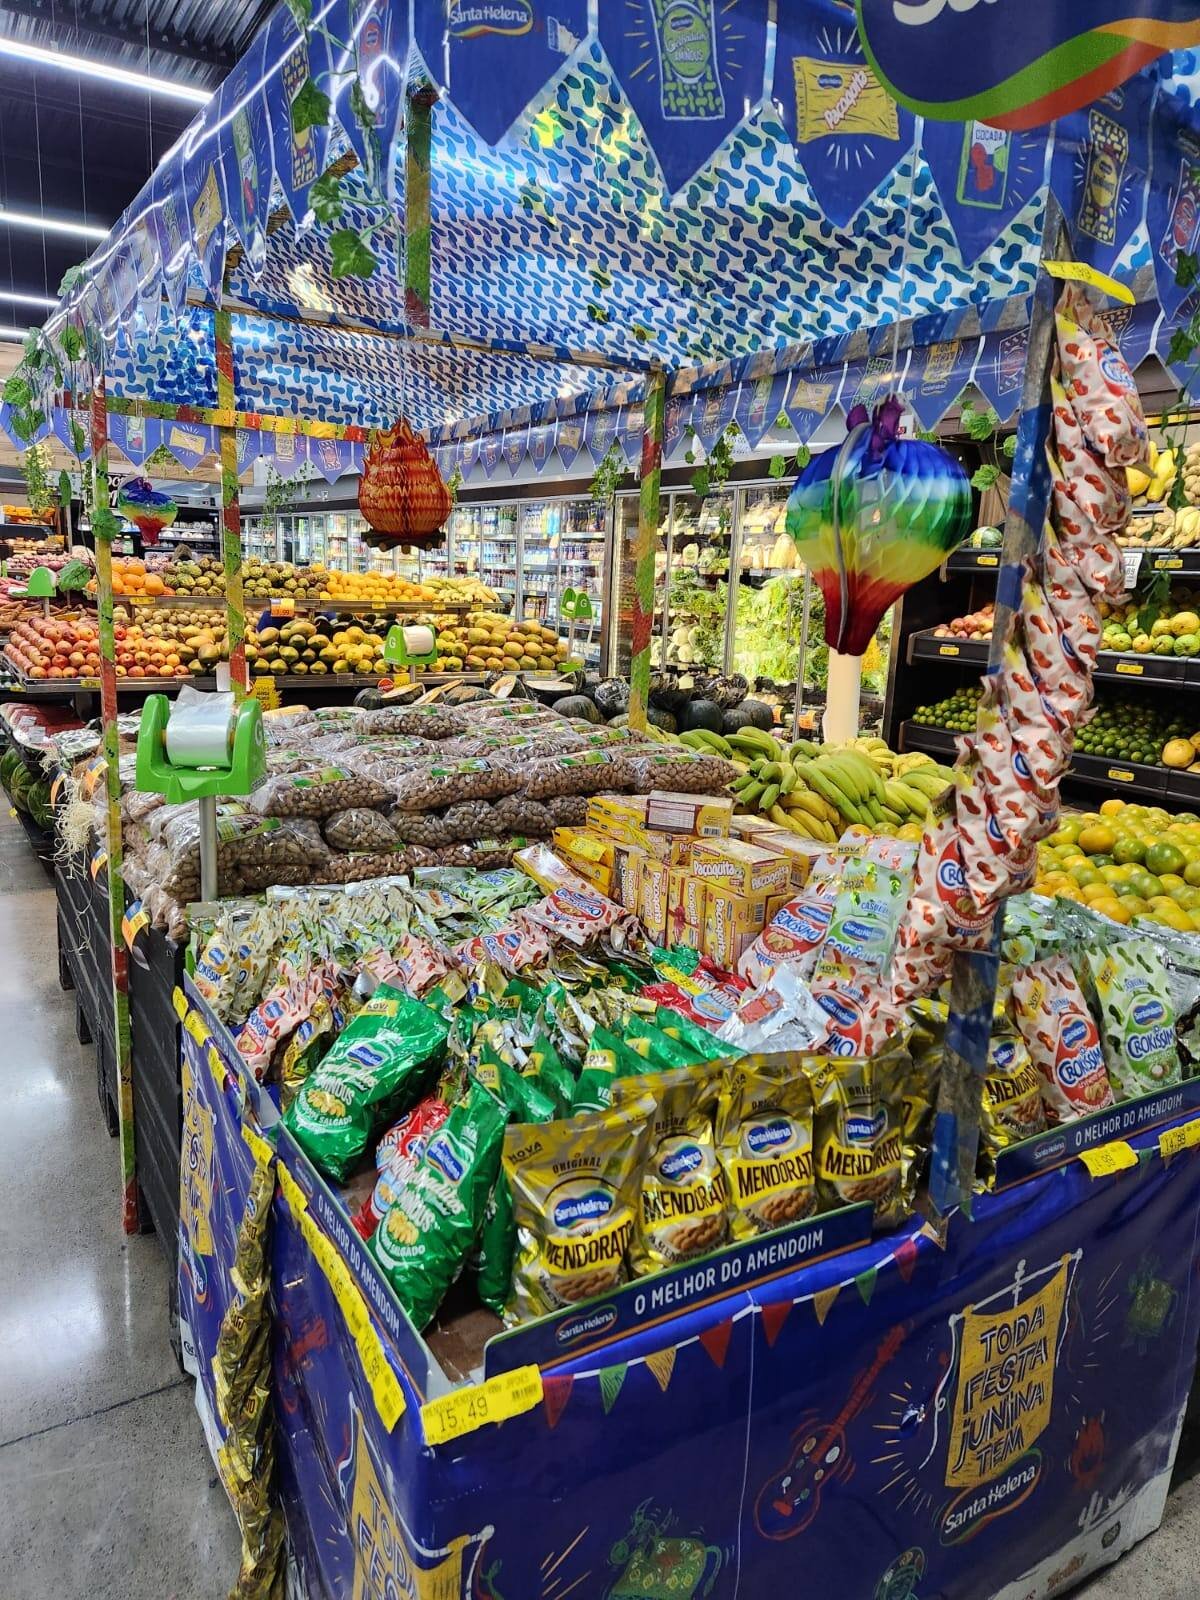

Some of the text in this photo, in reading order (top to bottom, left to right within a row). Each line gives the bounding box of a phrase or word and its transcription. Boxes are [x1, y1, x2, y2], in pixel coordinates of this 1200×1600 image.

[449, 5, 528, 25] Santa Helena
[1127, 1030, 1174, 1059] CROKISSIM
[985, 1063, 1037, 1106] MENDORAT
[1075, 1093, 1184, 1147] O MELHOR DO AMENDOIM
[508, 1141, 543, 1161] NOVA
[552, 1156, 601, 1175] ORIGINAL
[736, 1150, 813, 1199] MENDORAT
[643, 1173, 727, 1226] MENDORAT
[323, 1202, 350, 1256] MELHOR
[349, 1243, 361, 1271] DO
[360, 1261, 400, 1339] AMENDOIM
[634, 1229, 824, 1316] O MELHOR DO AMENDOIM
[557, 1310, 614, 1342] Santa Helena
[979, 1303, 1045, 1365] TODA
[962, 1335, 1048, 1415] FESTA
[976, 1429, 1024, 1477] TEM
[944, 1464, 1036, 1535] Santa Helena
